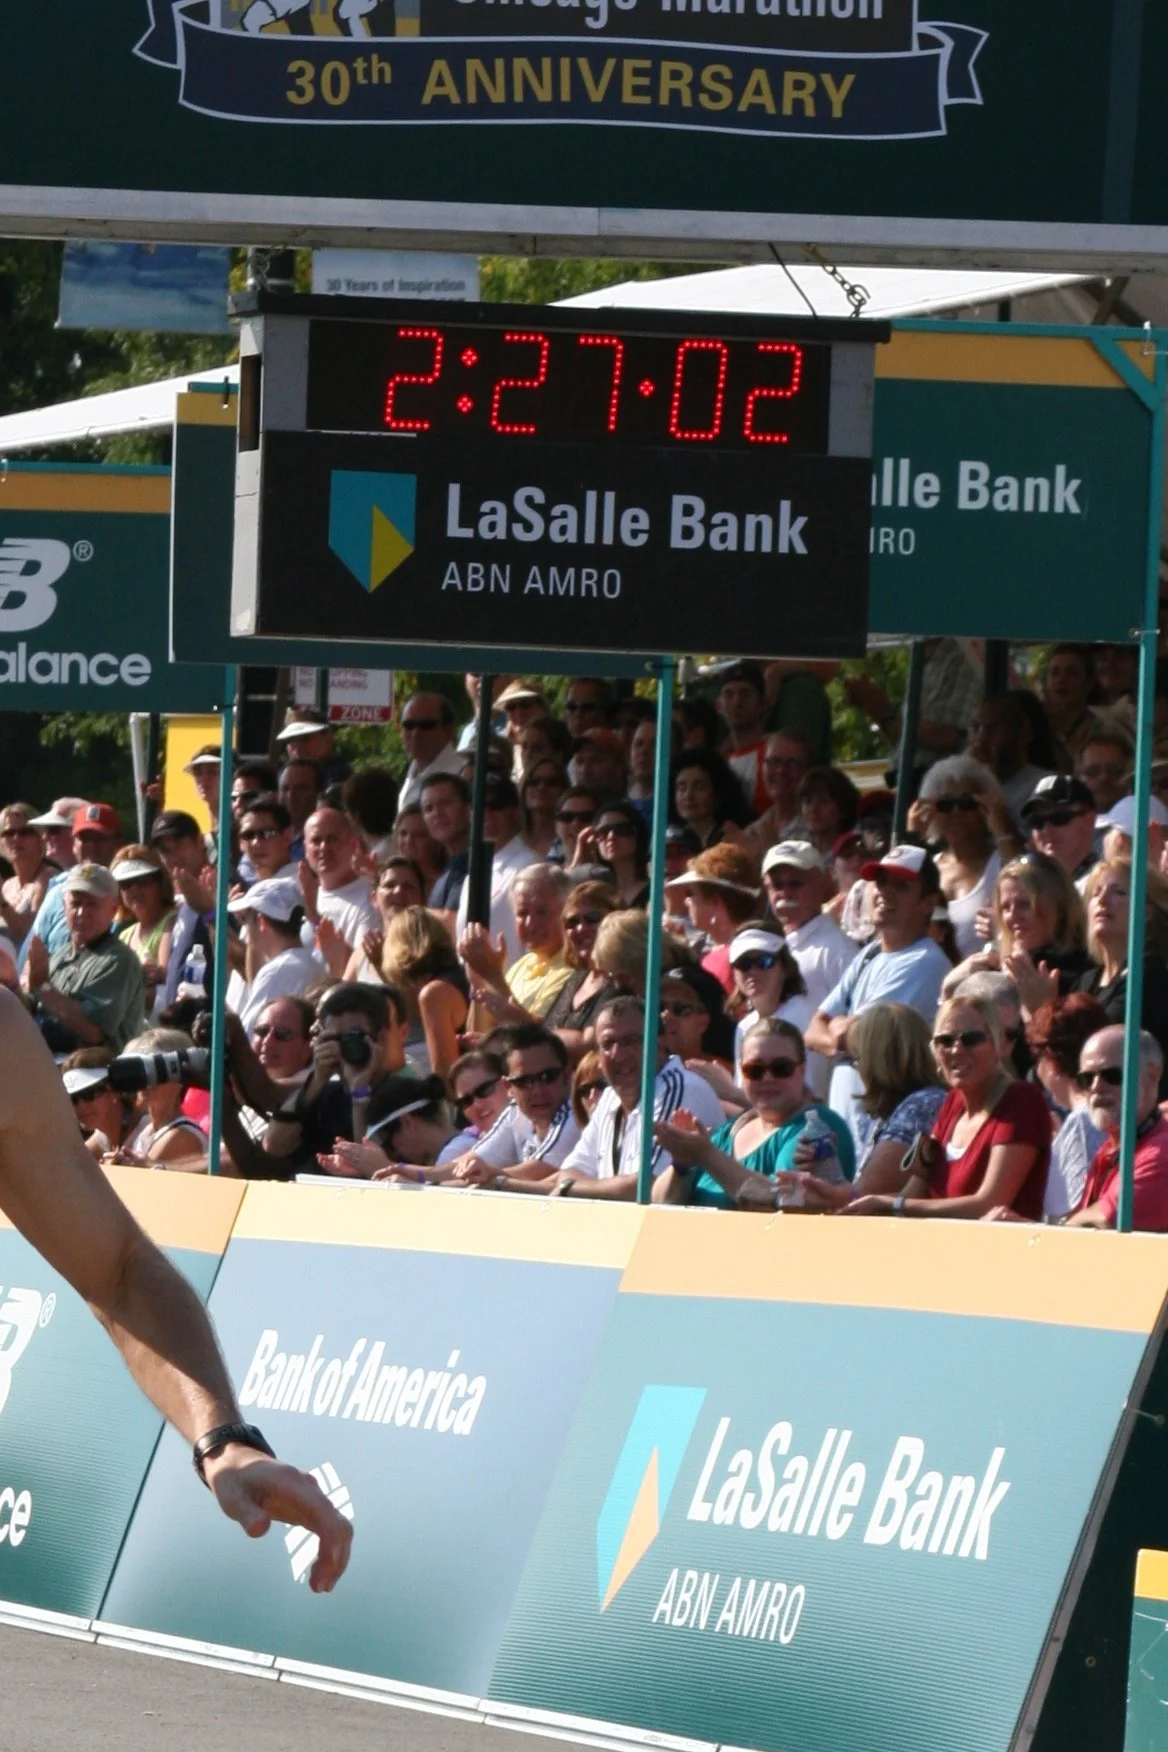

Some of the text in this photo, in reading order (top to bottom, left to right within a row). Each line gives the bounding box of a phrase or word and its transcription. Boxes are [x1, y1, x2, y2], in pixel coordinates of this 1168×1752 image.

[286, 54, 856, 119] 30th ANNIVERSARY
[345, 278, 378, 292] Years
[382, 278, 395, 291] of
[398, 278, 466, 294] Inspiration
[957, 460, 1082, 514] Bank
[446, 483, 809, 554] LaSalle Bank
[869, 527, 916, 555] RO
[441, 561, 621, 599] ABN AMRO
[341, 706, 382, 721] ZONE
[239, 1329, 487, 1435] Bank of America
[687, 1416, 1012, 1560] LaSalle Bank
[652, 1567, 806, 1645] ABN AMRO
